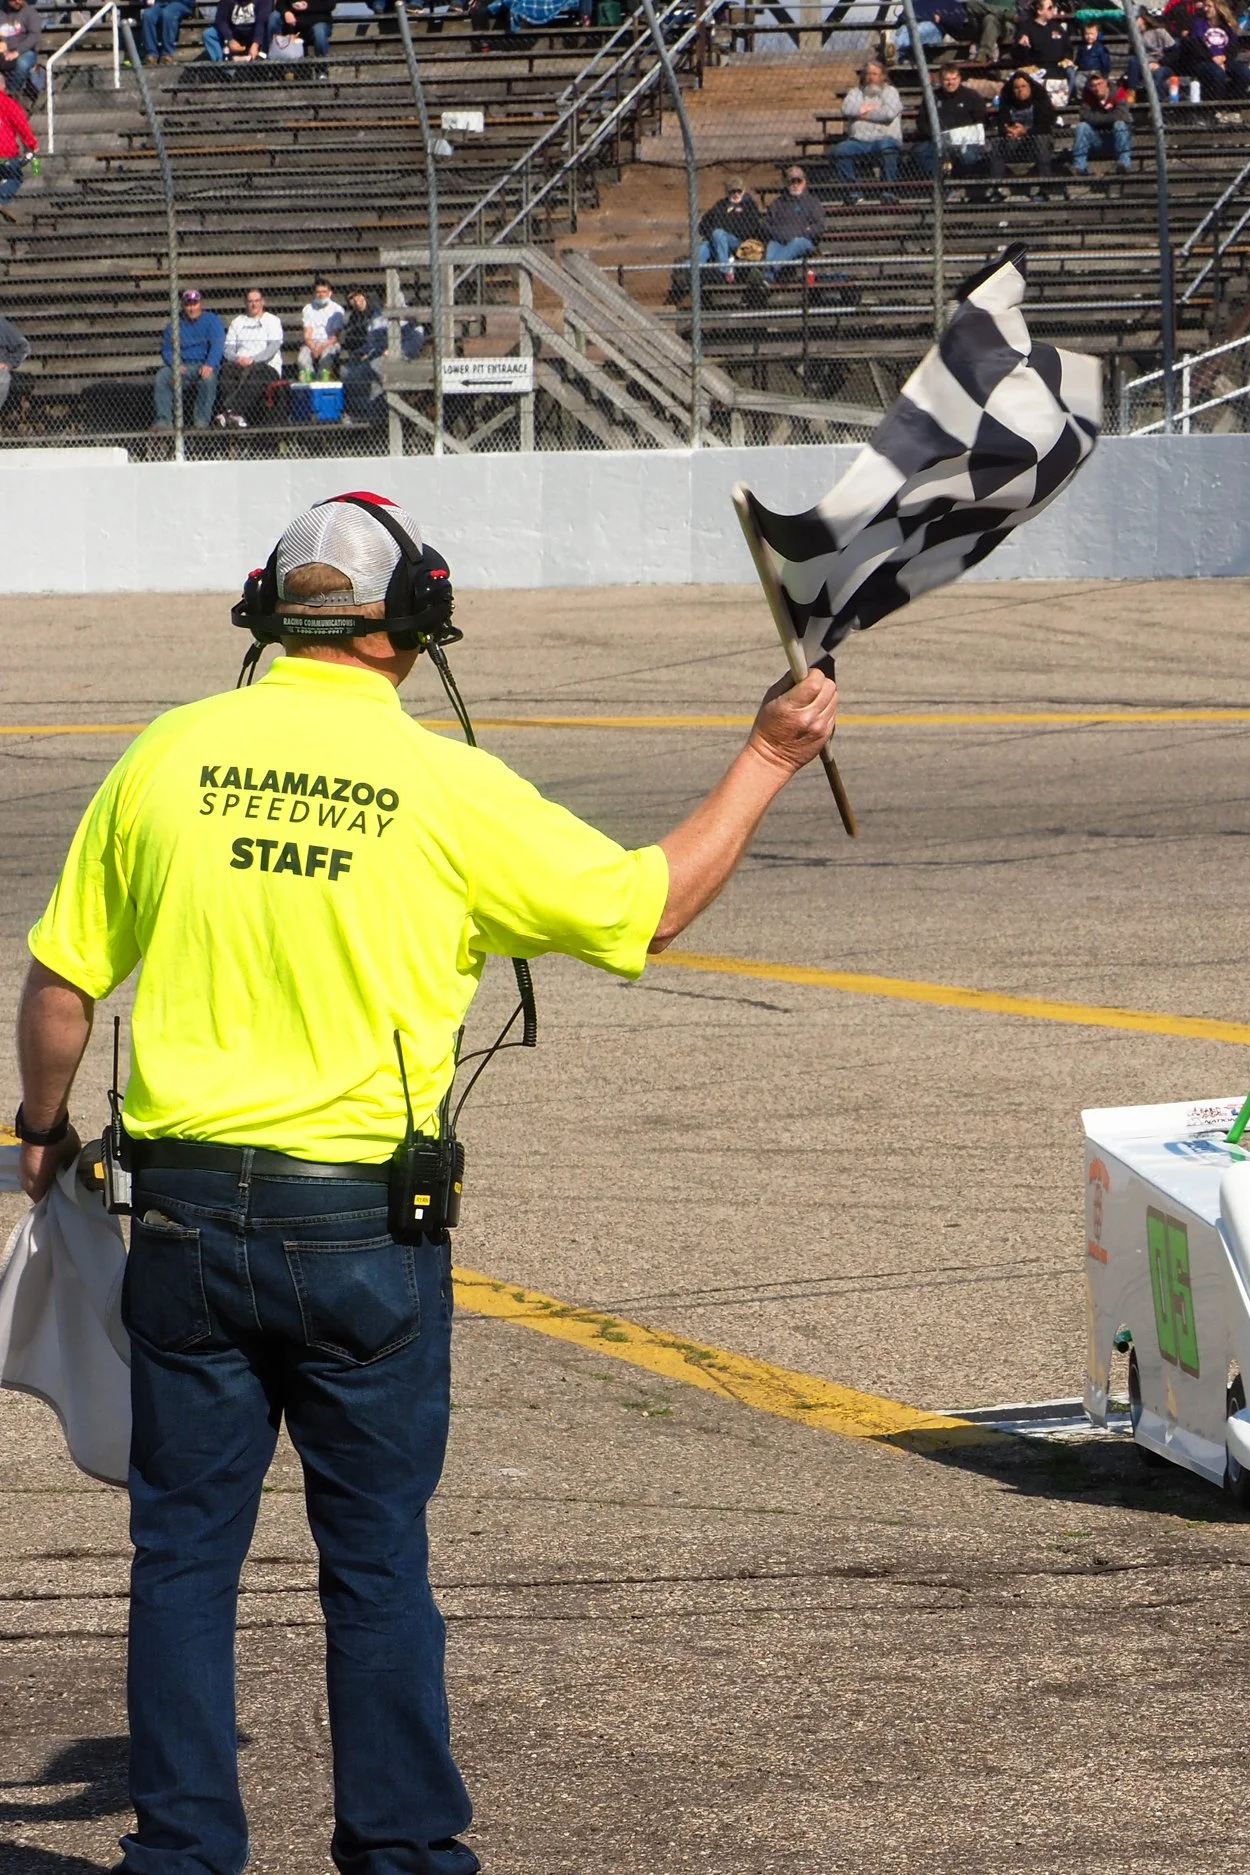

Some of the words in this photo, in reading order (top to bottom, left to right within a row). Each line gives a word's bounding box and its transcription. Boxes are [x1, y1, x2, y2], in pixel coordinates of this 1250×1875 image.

[443, 364, 470, 375] LOWER
[472, 364, 485, 375] PIT
[487, 363, 528, 374] ENTRANCE
[283, 617, 303, 626] RACING
[199, 765, 400, 812] KALAMAZOO
[199, 792, 395, 838] SPEEDWAY
[229, 836, 353, 881] STAFF
